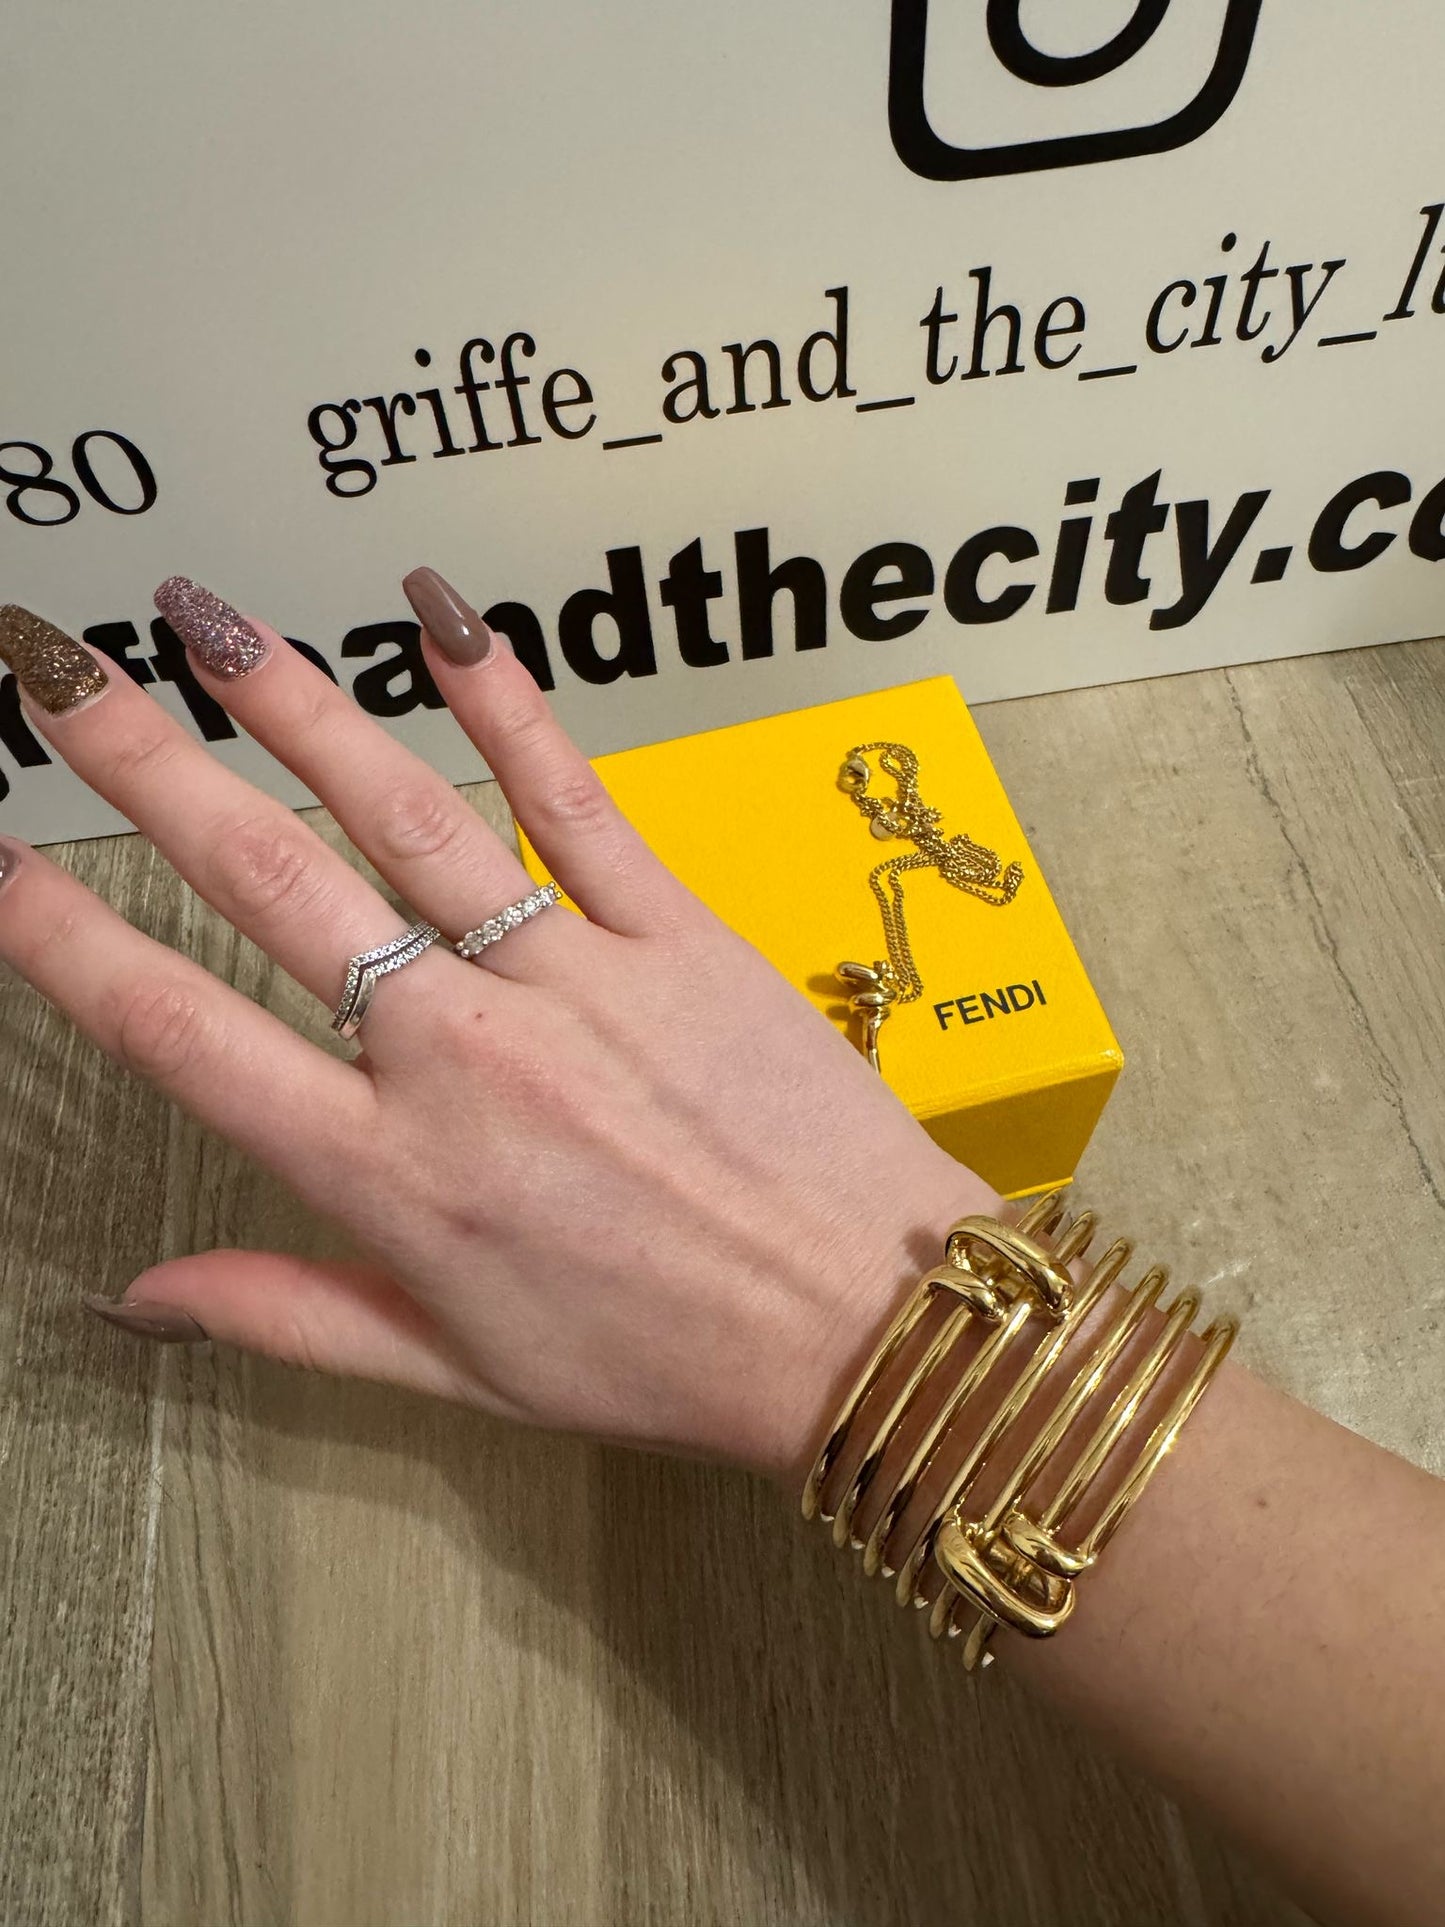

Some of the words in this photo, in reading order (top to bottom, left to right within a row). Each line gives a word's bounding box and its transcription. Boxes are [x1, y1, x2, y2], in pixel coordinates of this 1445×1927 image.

[308, 203, 1445, 498] griffe_and_the_city_l
[0, 430, 158, 527] 80
[933, 979, 1047, 1031] FENDI
